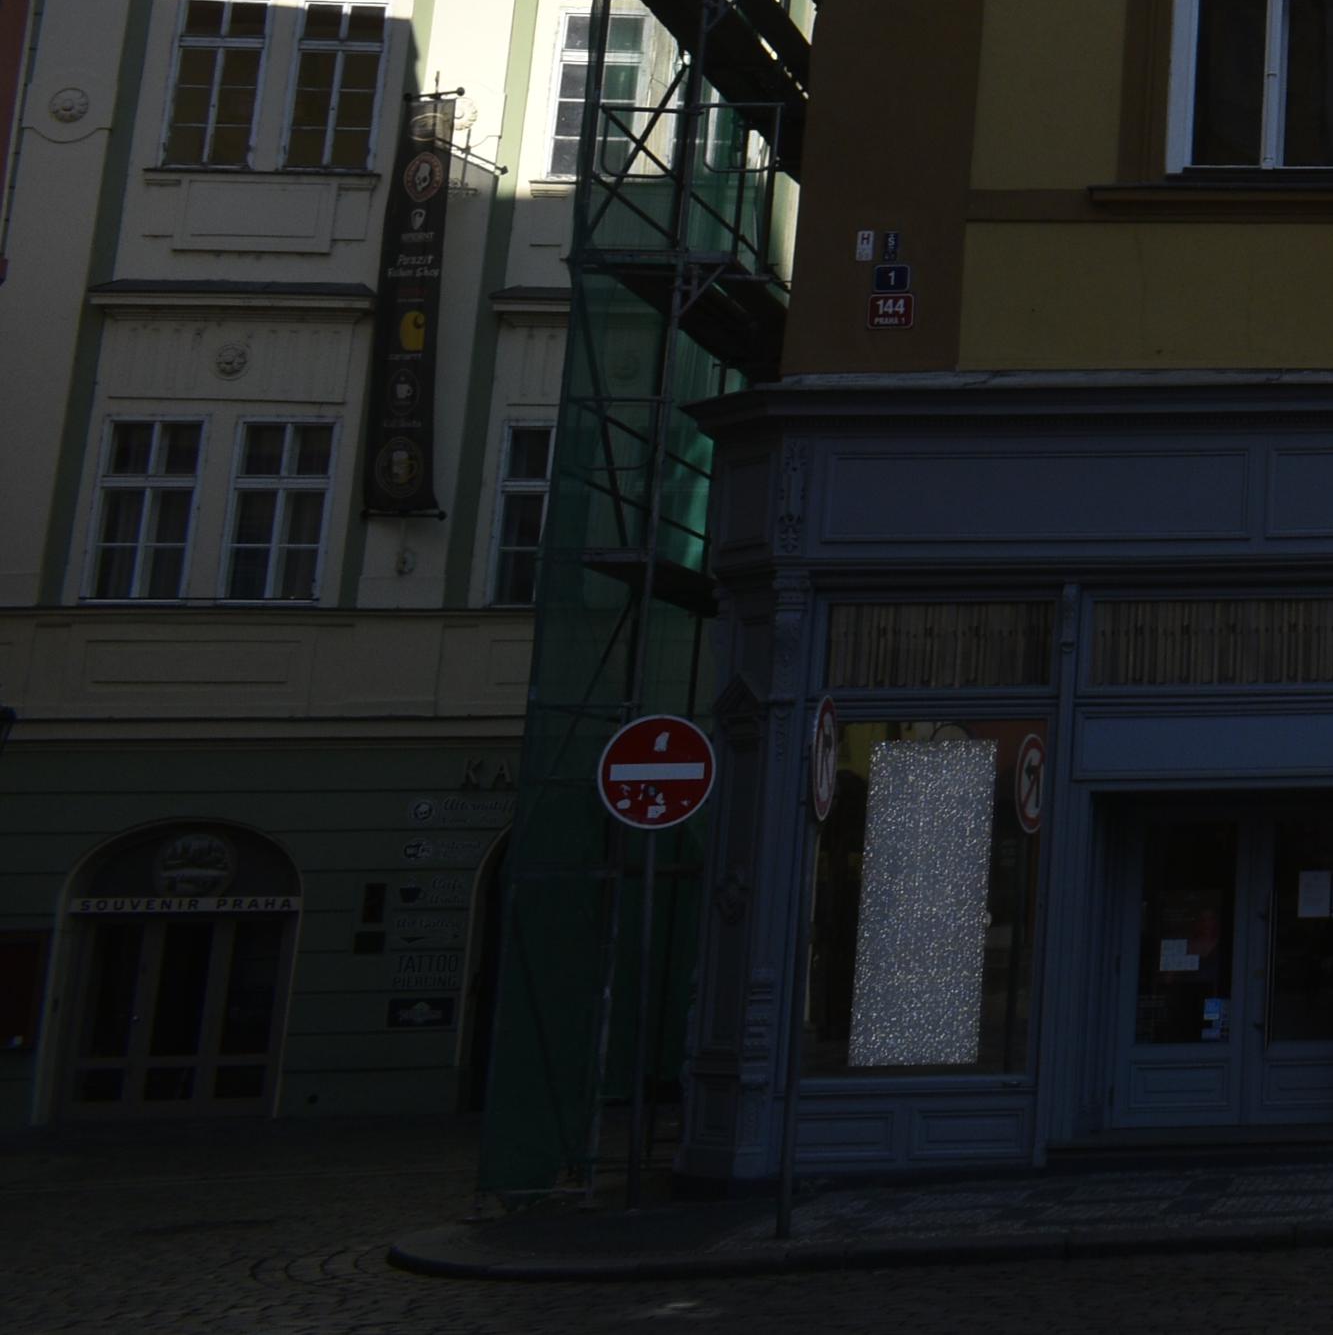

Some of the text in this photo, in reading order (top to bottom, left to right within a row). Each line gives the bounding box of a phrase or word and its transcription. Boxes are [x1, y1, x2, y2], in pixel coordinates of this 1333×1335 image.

[888, 270, 896, 286] 1
[876, 298, 905, 315] 144
[80, 898, 292, 912] SOUVENIR PRAHA
[399, 954, 458, 973] TATTOO
[393, 976, 456, 988] PIERCING
